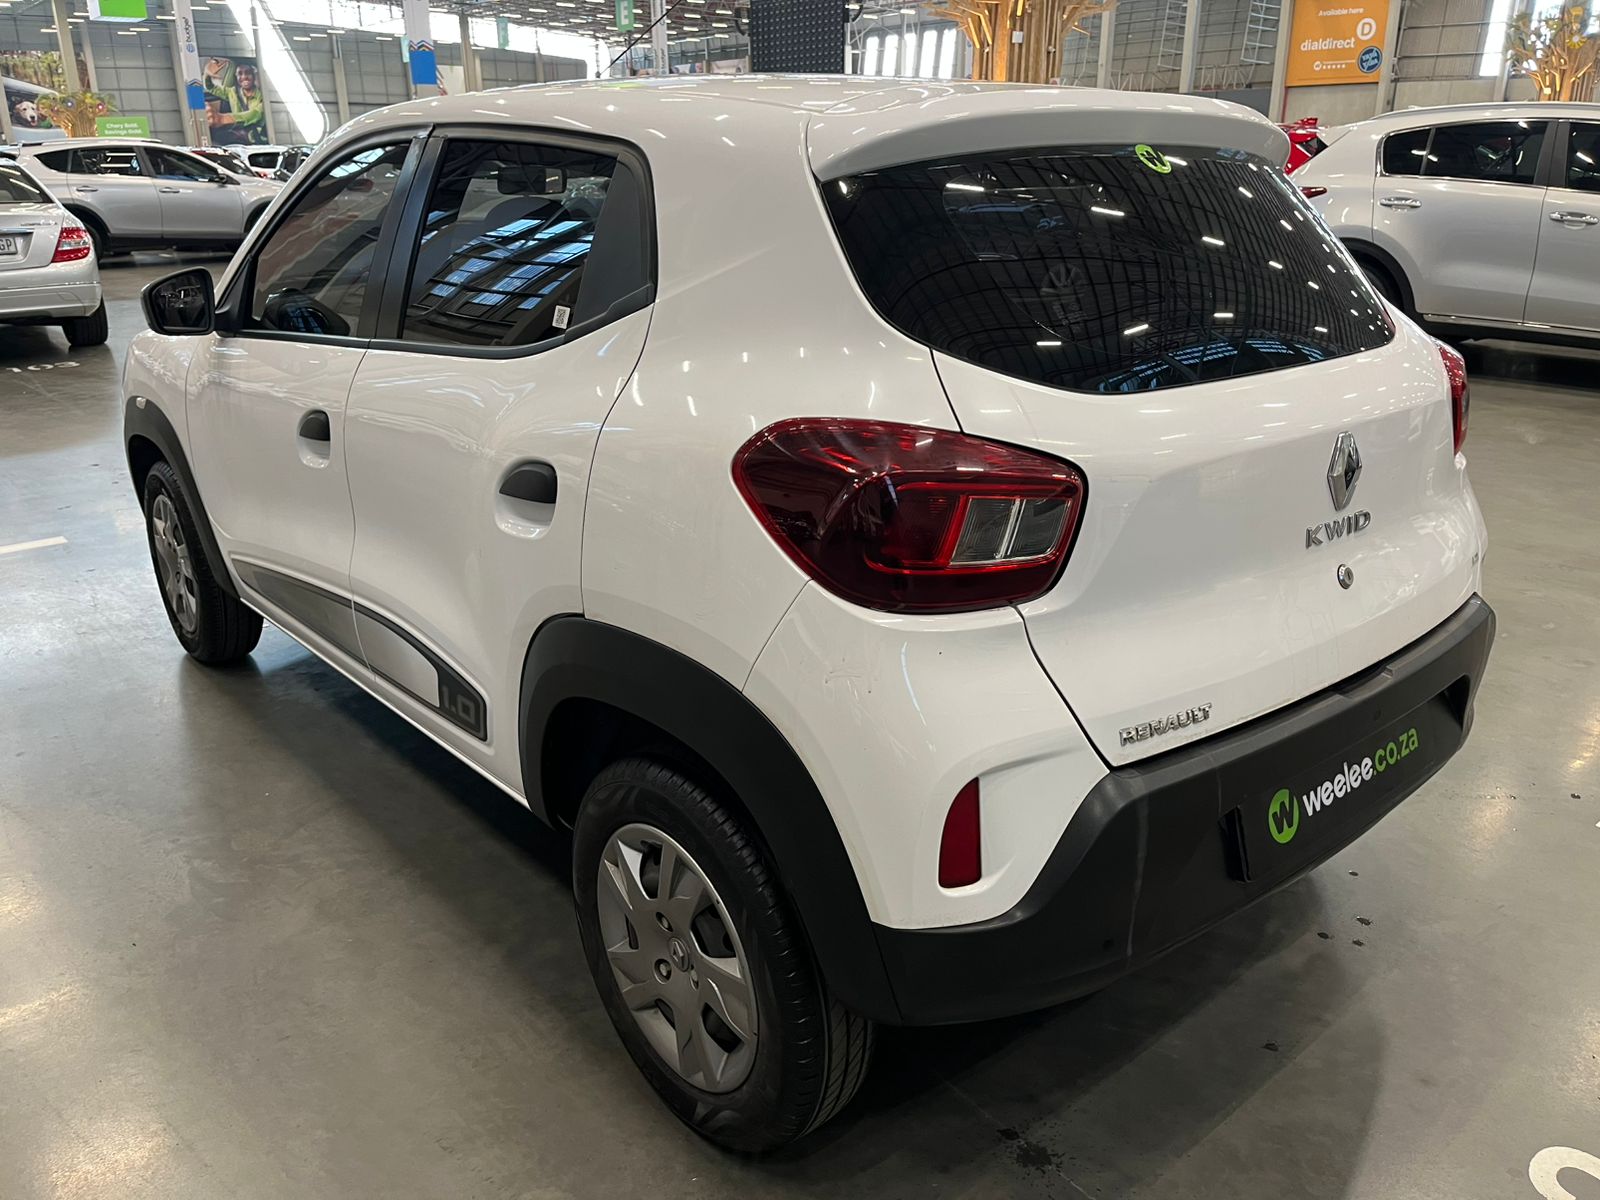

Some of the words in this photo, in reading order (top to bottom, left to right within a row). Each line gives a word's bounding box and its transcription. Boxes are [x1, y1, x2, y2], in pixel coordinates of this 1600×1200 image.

[619, 0, 630, 25] E
[1318, 8, 1348, 17] Available
[1348, 7, 1365, 15] here
[1300, 37, 1356, 52] dialdirect
[1305, 509, 1371, 549] KWID
[441, 685, 476, 724] 1.0
[1119, 702, 1213, 747] RENAULT
[1302, 728, 1420, 817] weelee.co.za
